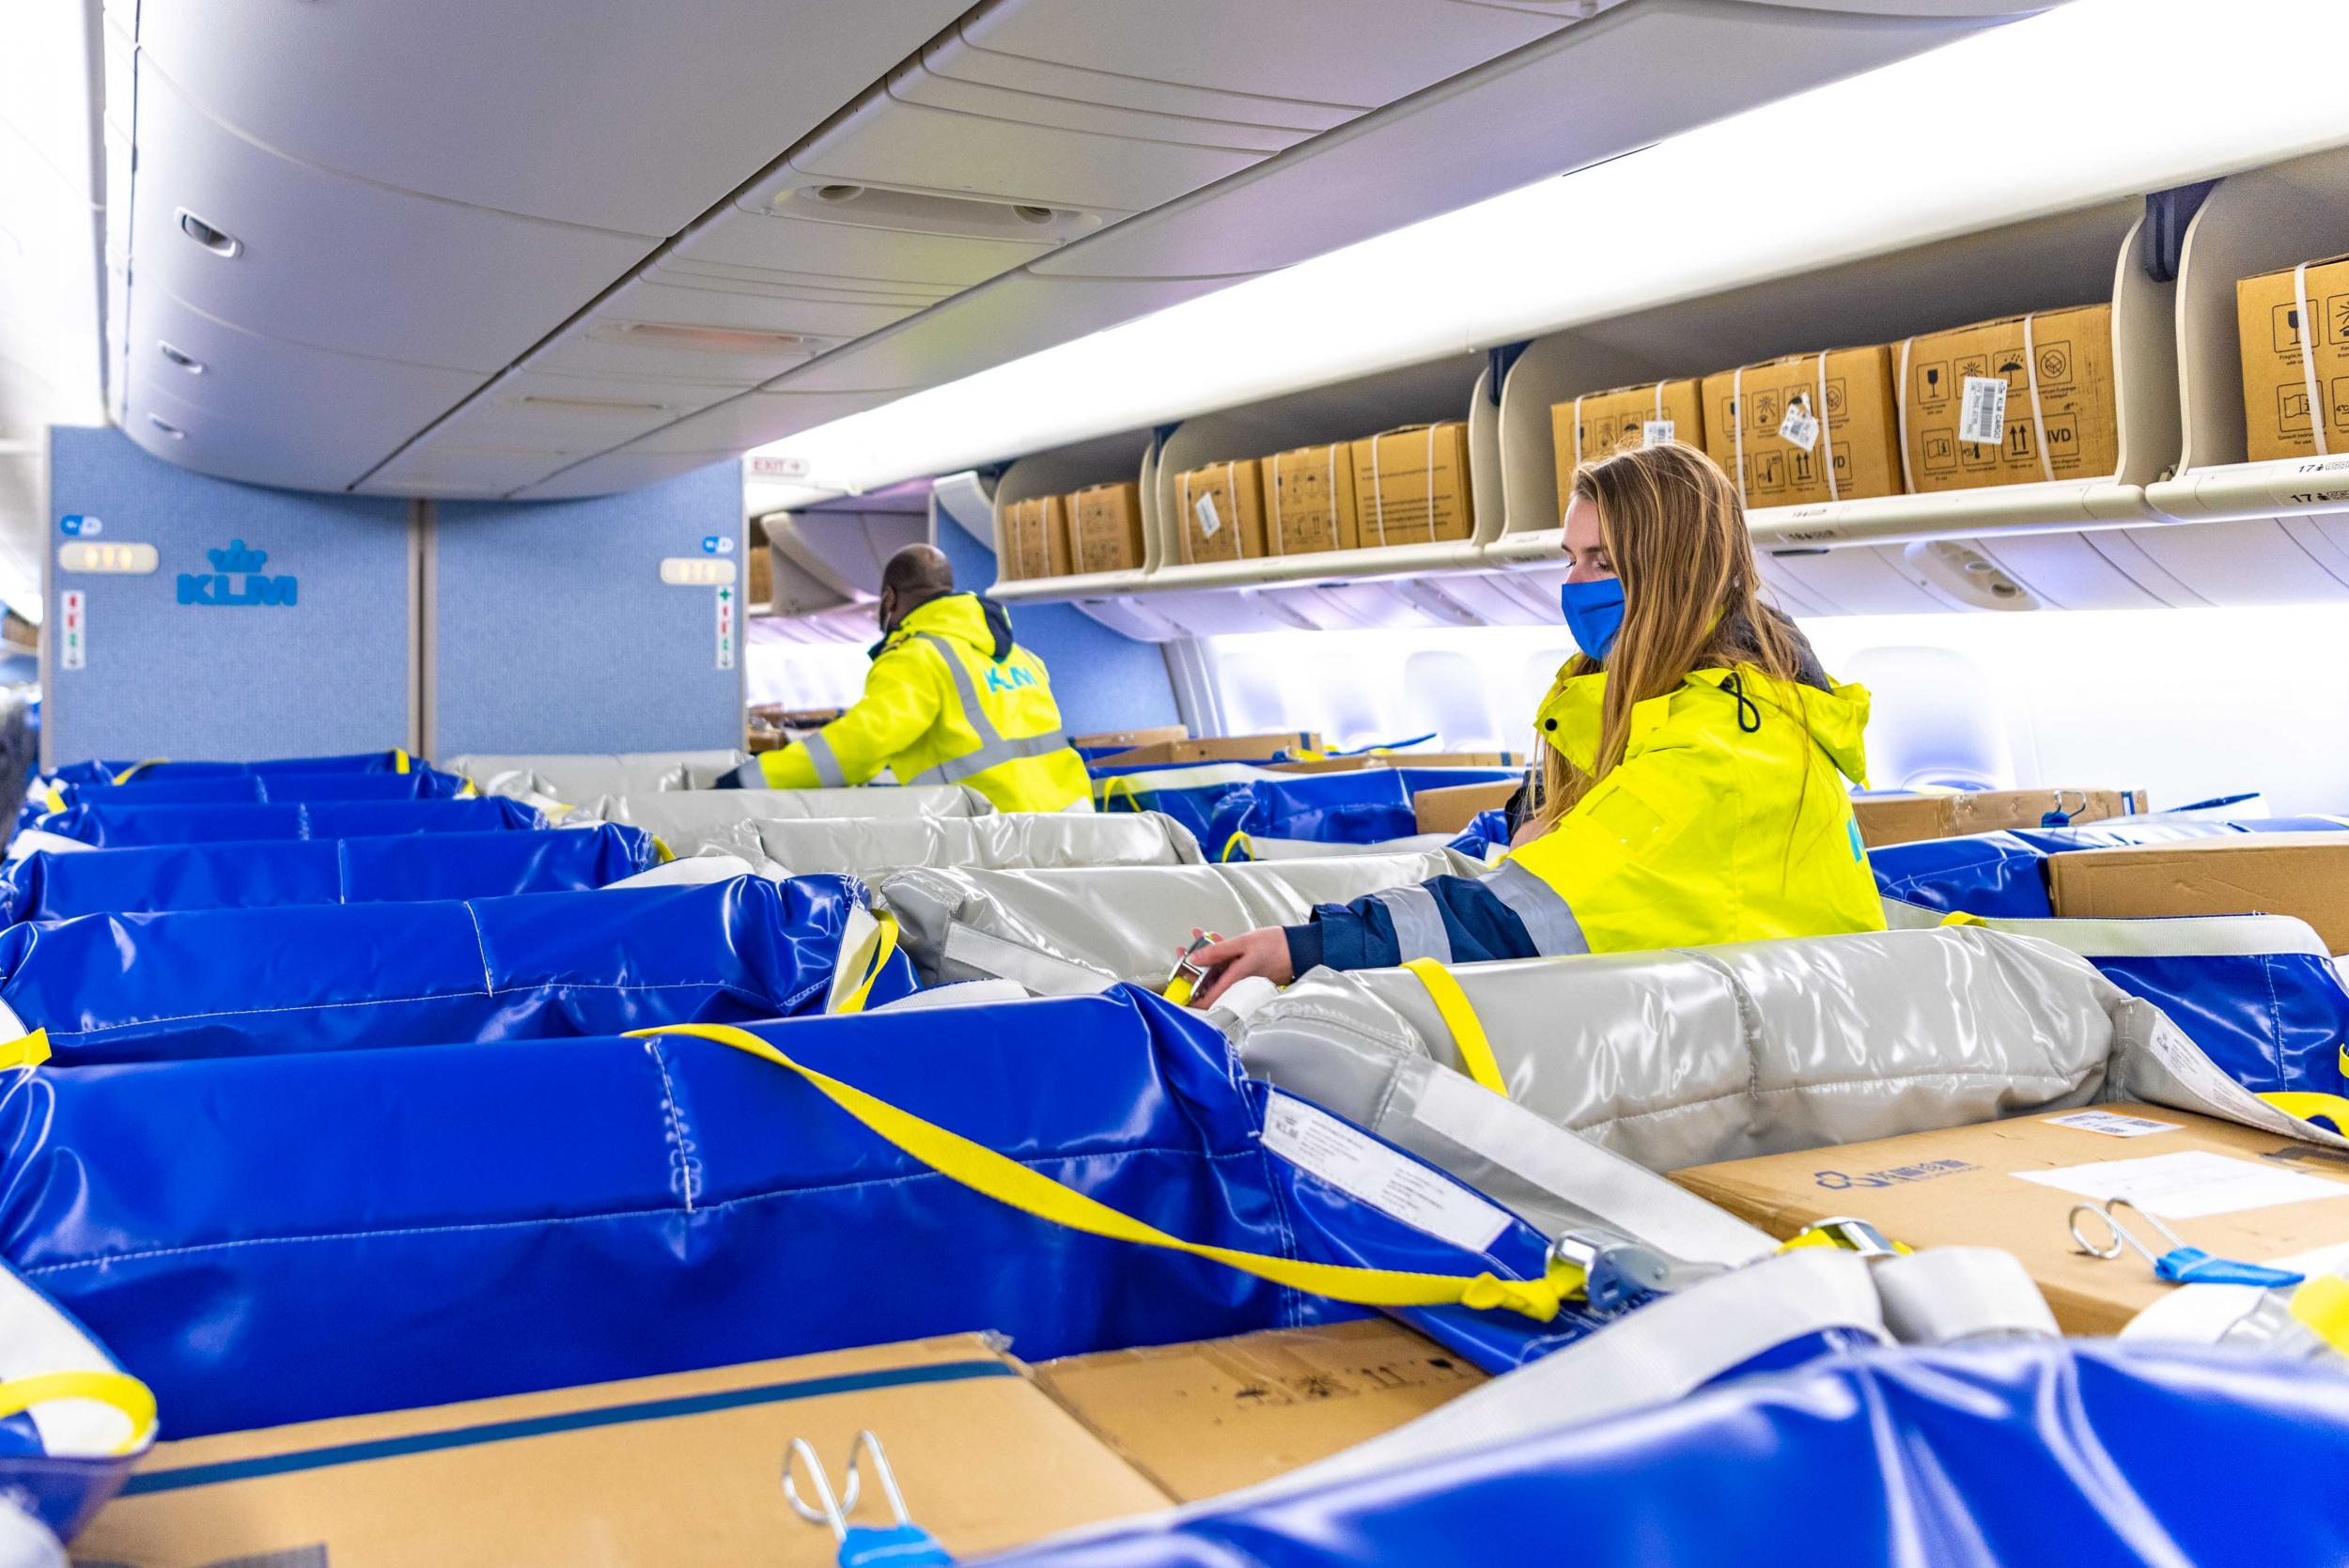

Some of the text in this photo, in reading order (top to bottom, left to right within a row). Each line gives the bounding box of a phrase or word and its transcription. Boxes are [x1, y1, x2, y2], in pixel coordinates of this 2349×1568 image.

[2046, 427, 2072, 444] IVD
[753, 458, 786, 471] EXIT
[2298, 464, 2316, 473] 17
[2290, 493, 2312, 504] 17
[177, 573, 298, 606] KLM
[983, 665, 1038, 692] KLM
